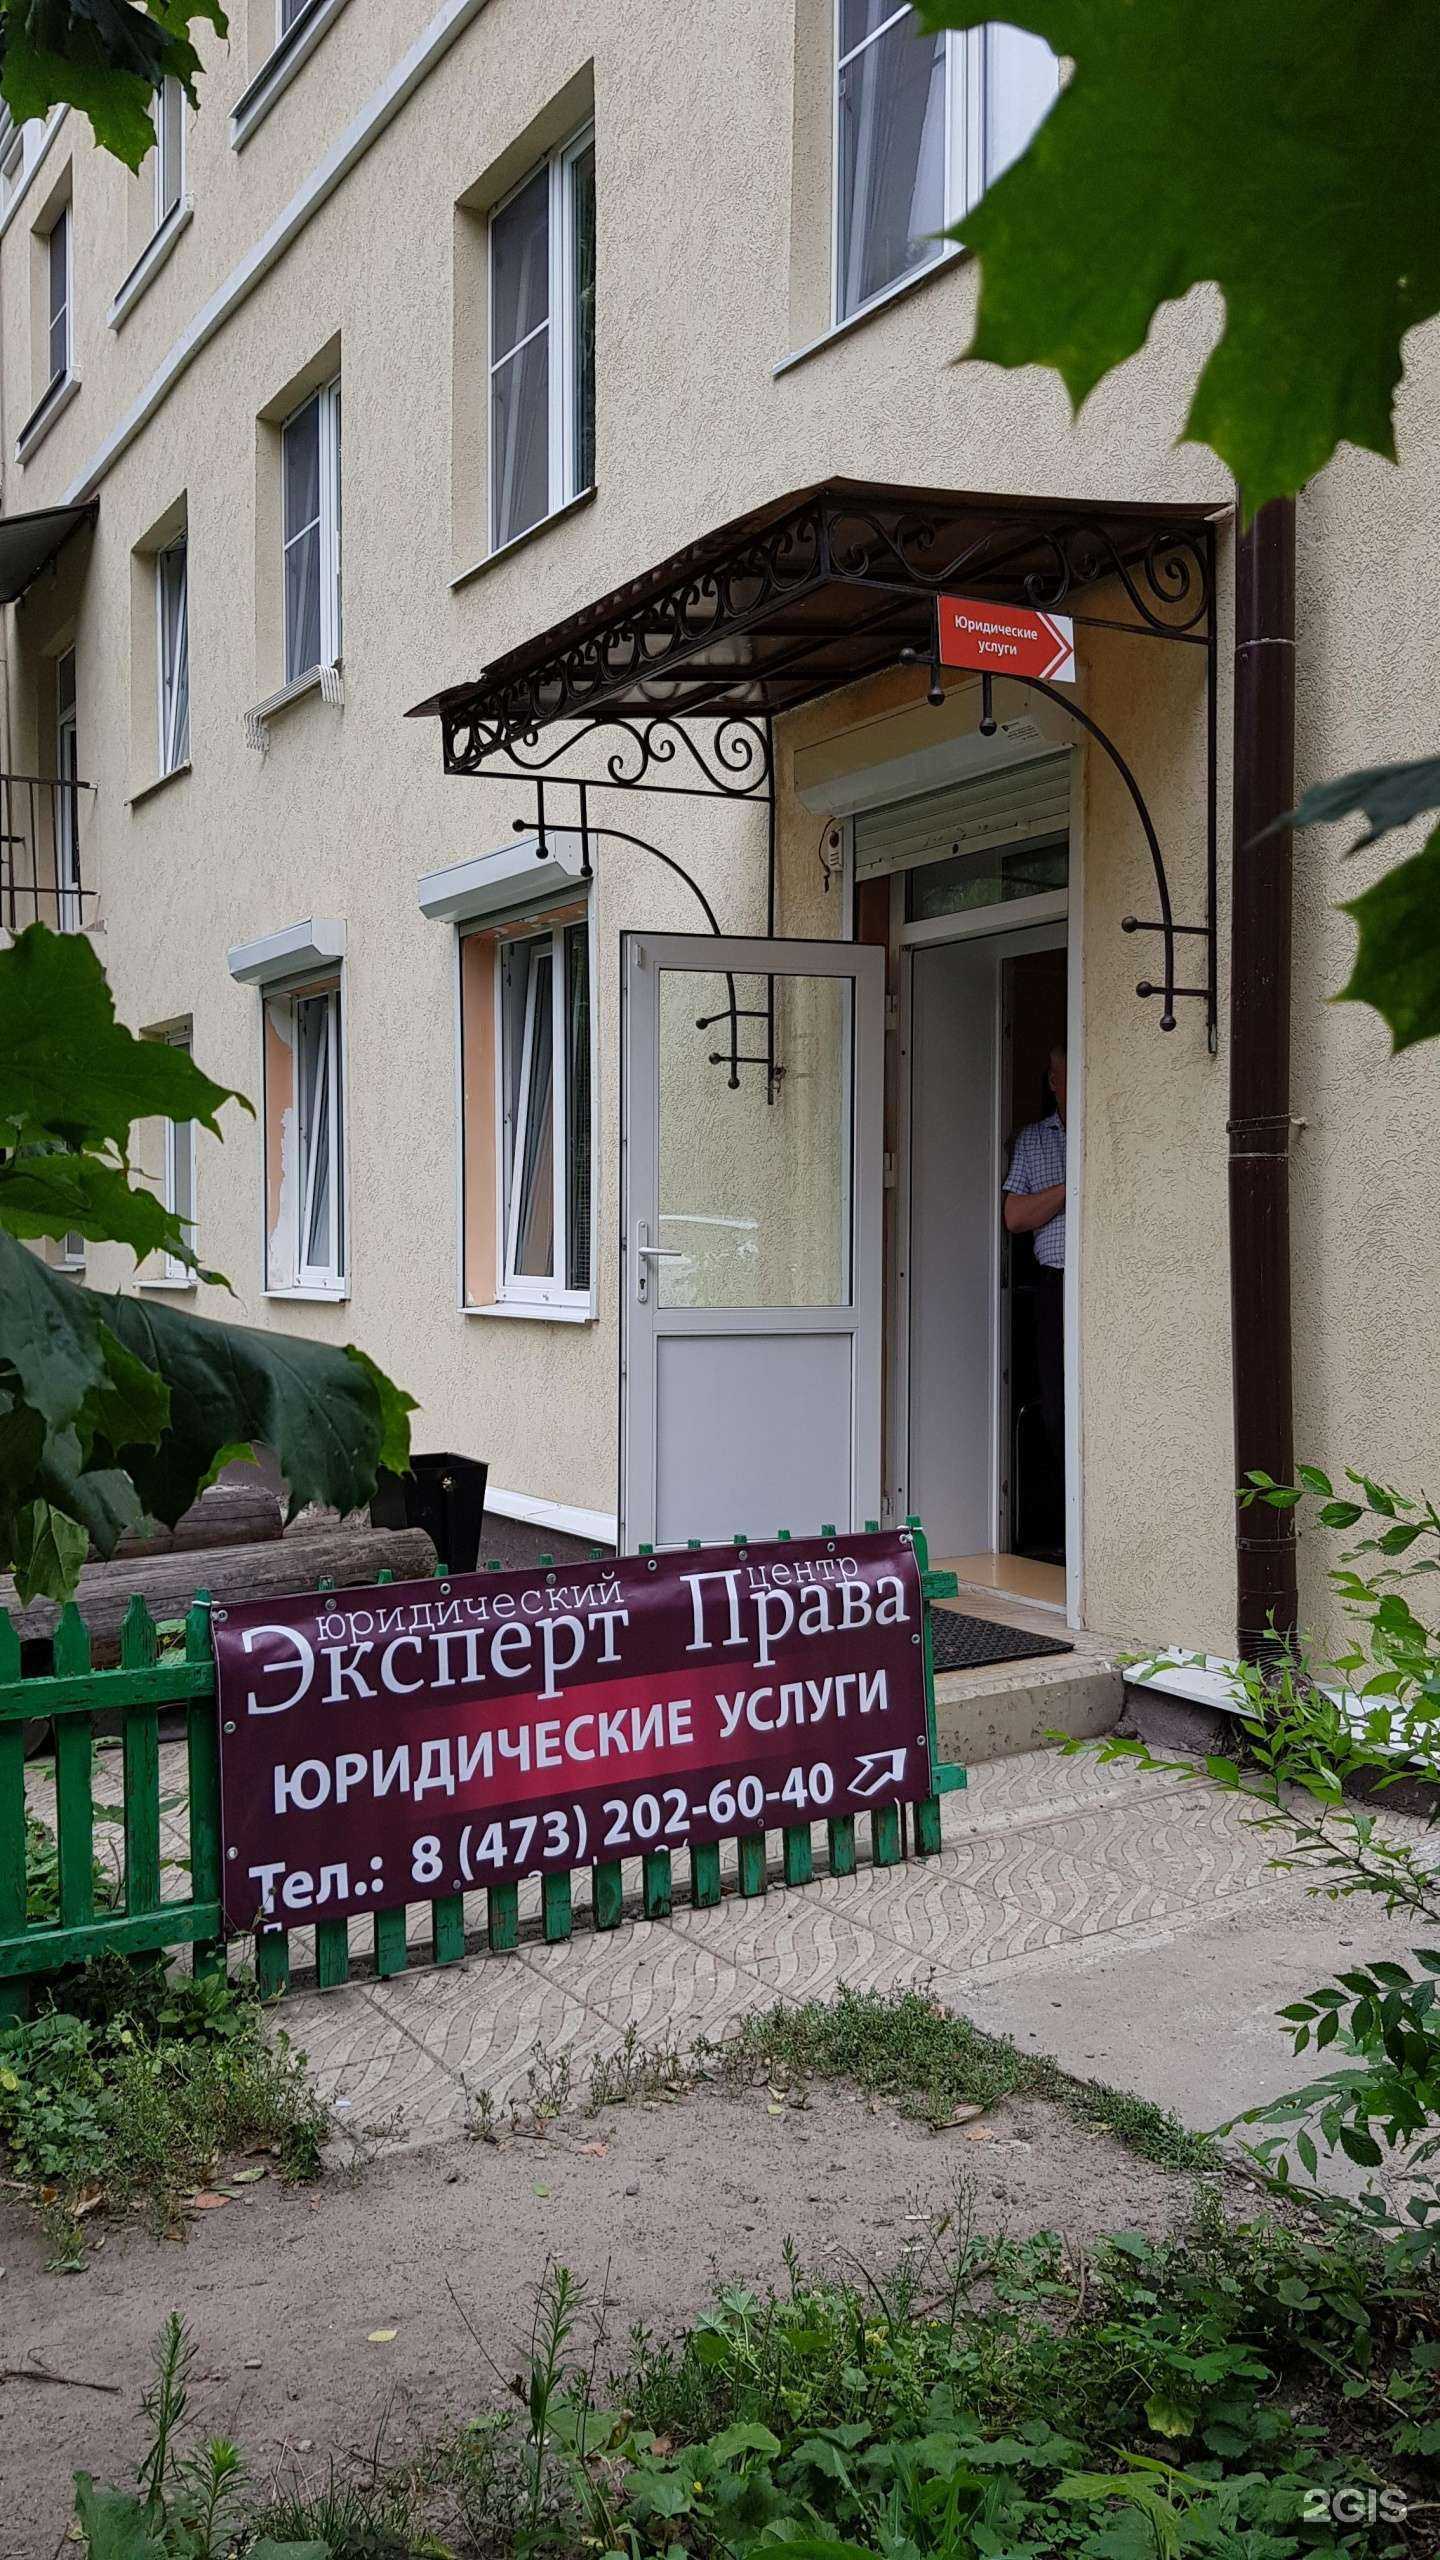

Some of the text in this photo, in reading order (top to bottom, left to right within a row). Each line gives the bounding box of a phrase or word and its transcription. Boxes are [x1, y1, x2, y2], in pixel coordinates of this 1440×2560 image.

[955, 614, 1038, 640] Юридические
[978, 640, 1018, 656] услуги
[241, 1569, 911, 1716] Эксперт Права
[314, 1556, 858, 1645] юридический центр
[273, 1669, 889, 1815] ЮРИДИЧЕСКИЕ УСЛУГИ
[248, 1762, 835, 1915] Тел.: 8 (473) 202-60-40
